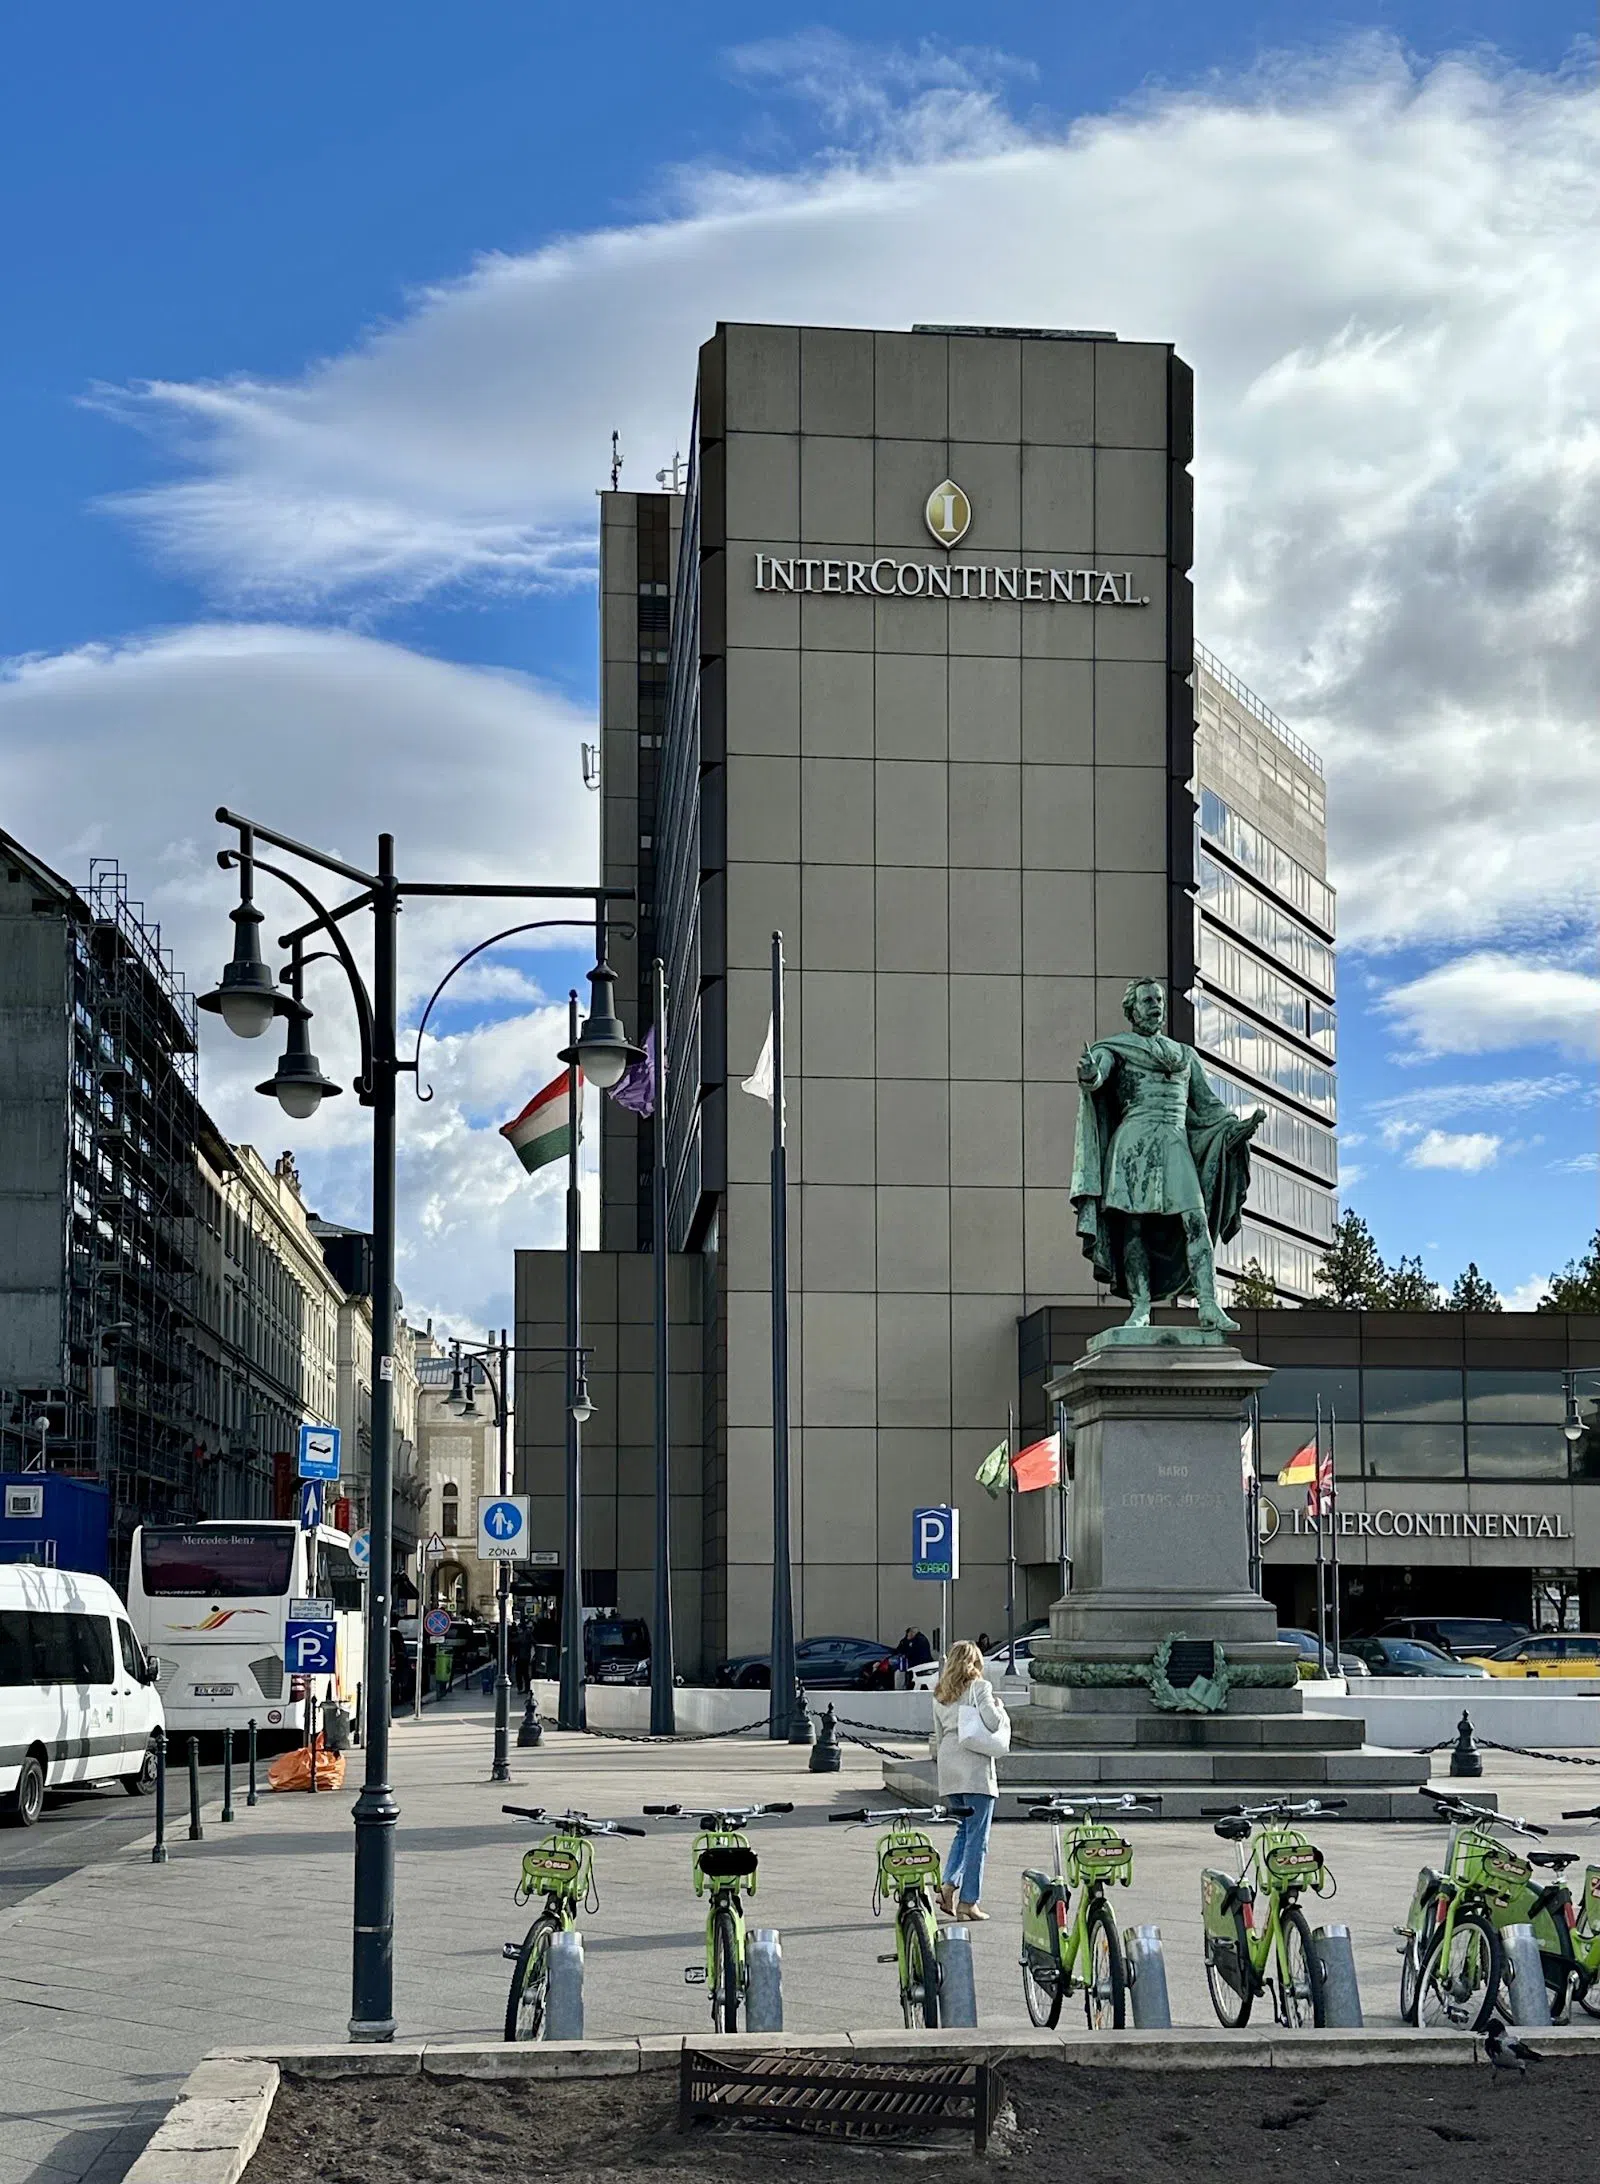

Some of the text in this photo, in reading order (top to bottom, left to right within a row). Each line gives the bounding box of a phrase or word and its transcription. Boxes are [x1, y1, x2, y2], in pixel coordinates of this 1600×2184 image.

[181, 1535, 256, 1545] Mercedes-Benz
[921, 1518, 945, 1559] P
[297, 1637, 321, 1667] P
